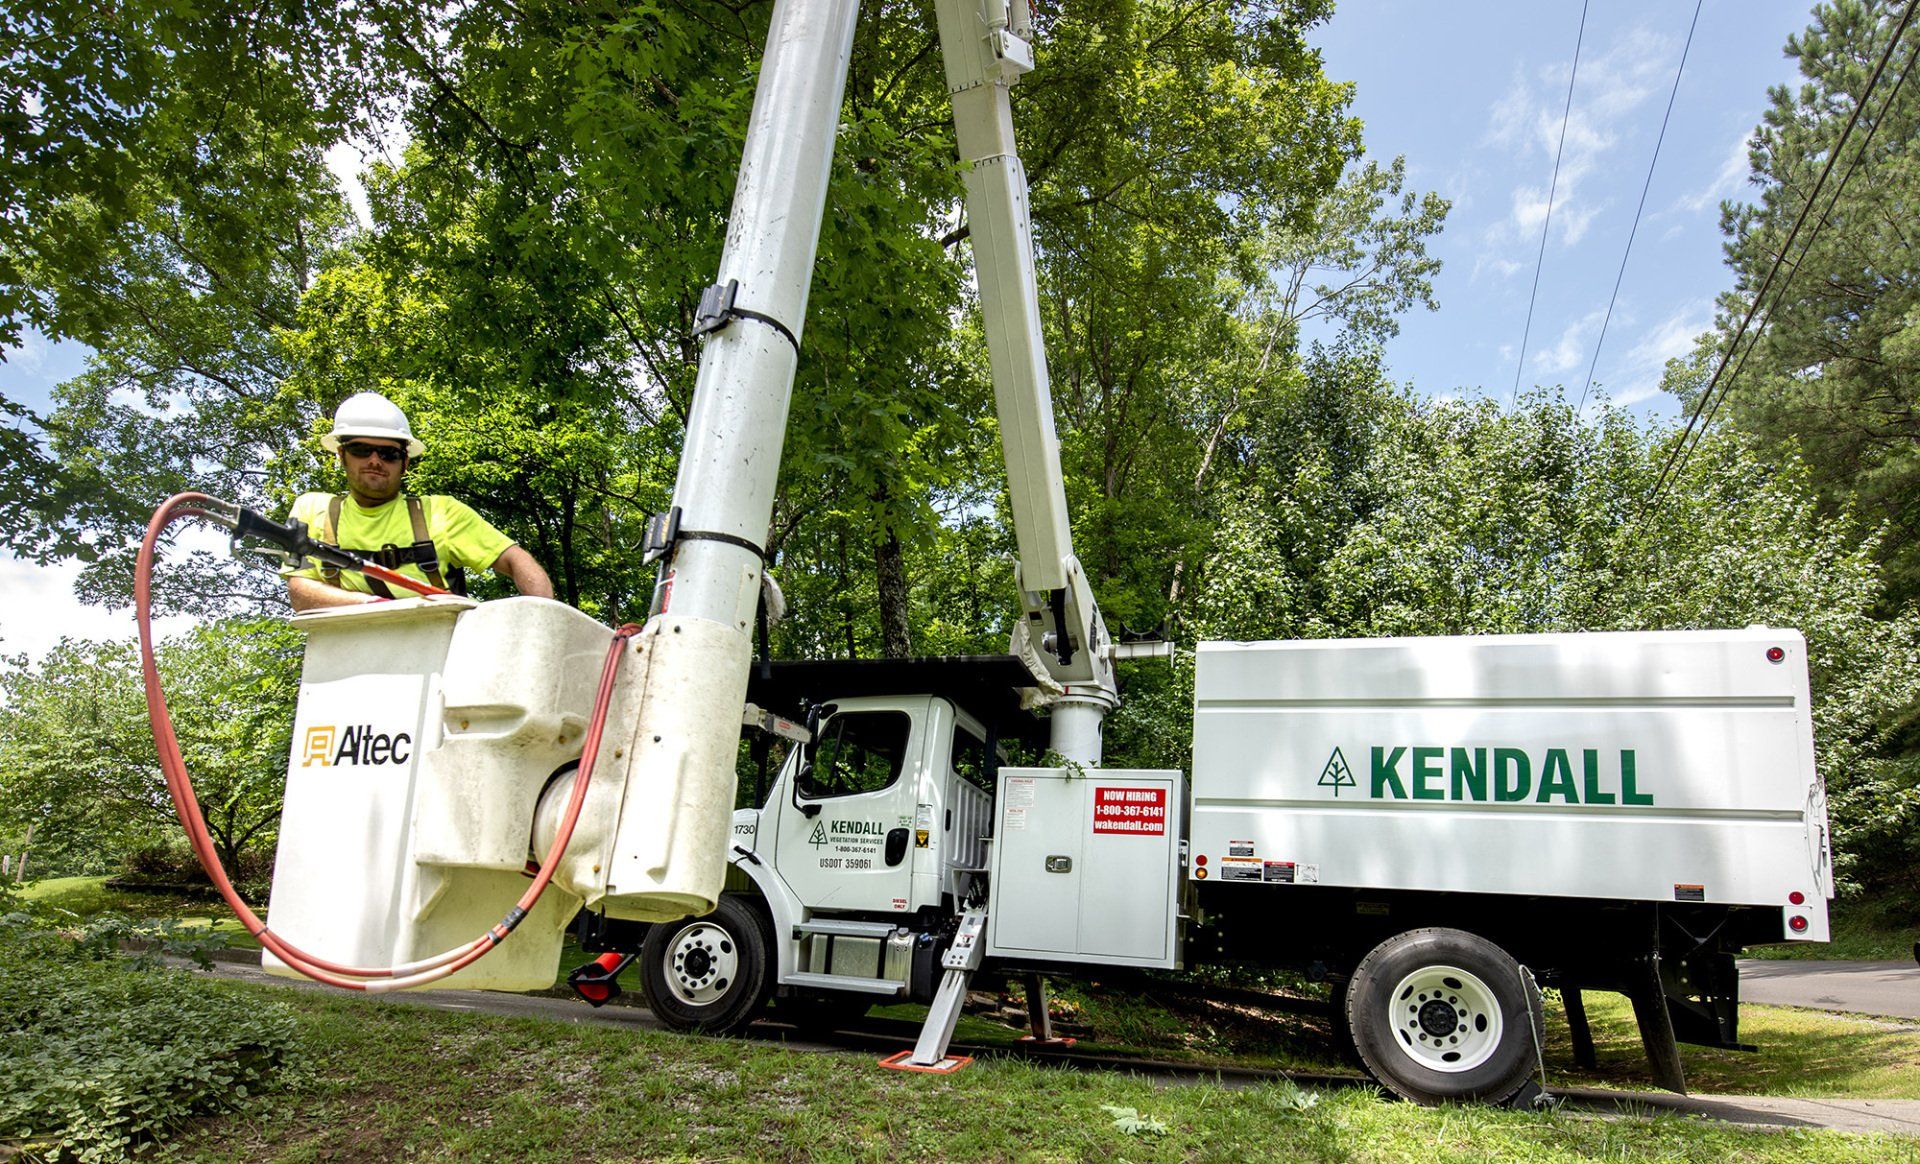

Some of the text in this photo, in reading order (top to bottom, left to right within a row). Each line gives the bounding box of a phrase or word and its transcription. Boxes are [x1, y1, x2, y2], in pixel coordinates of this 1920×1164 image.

[333, 724, 411, 766] Altec
[1370, 745, 1654, 806] KENDALL
[1103, 790, 1157, 802] NOW HIRING
[1096, 805, 1164, 817] 1-800-367-6141
[734, 824, 756, 835] 1730
[831, 820, 884, 836] KENDALL
[1094, 820, 1163, 832] wakendall.com
[835, 846, 877, 854] 1-800-367-6141
[819, 858, 872, 869] USDOT 359061
